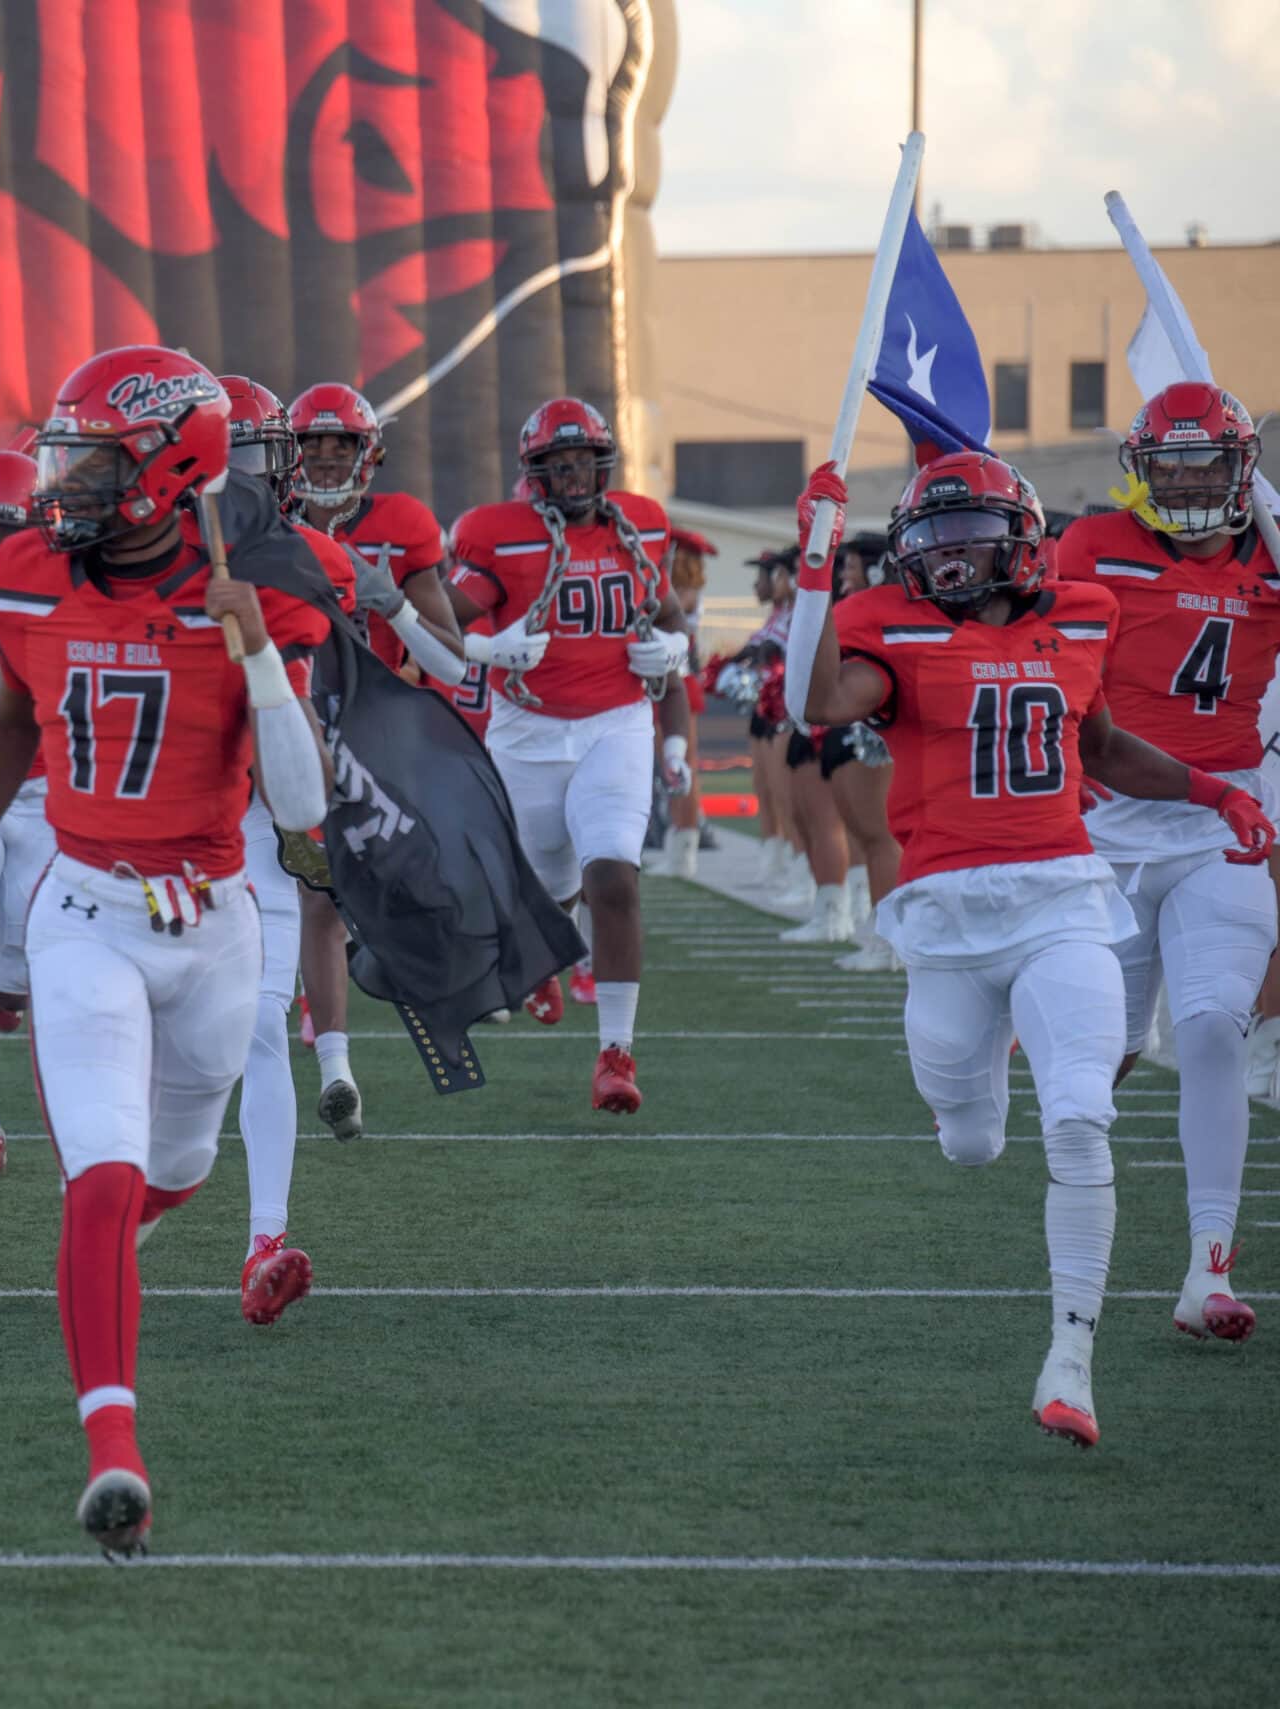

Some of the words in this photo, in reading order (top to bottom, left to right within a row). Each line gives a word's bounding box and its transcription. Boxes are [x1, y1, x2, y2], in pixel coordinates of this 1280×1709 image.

[1169, 431, 1205, 440] Riddell
[554, 571, 634, 638] 90
[1176, 592, 1219, 612] CEDAR
[1224, 597, 1250, 616] HILL
[66, 640, 118, 664] CEDAR
[124, 643, 162, 666] HILL
[971, 661, 1018, 679] CEDAR
[1021, 661, 1056, 679] HILL
[1168, 616, 1236, 716] 4
[57, 666, 171, 799] 17
[966, 682, 1069, 799] 10
